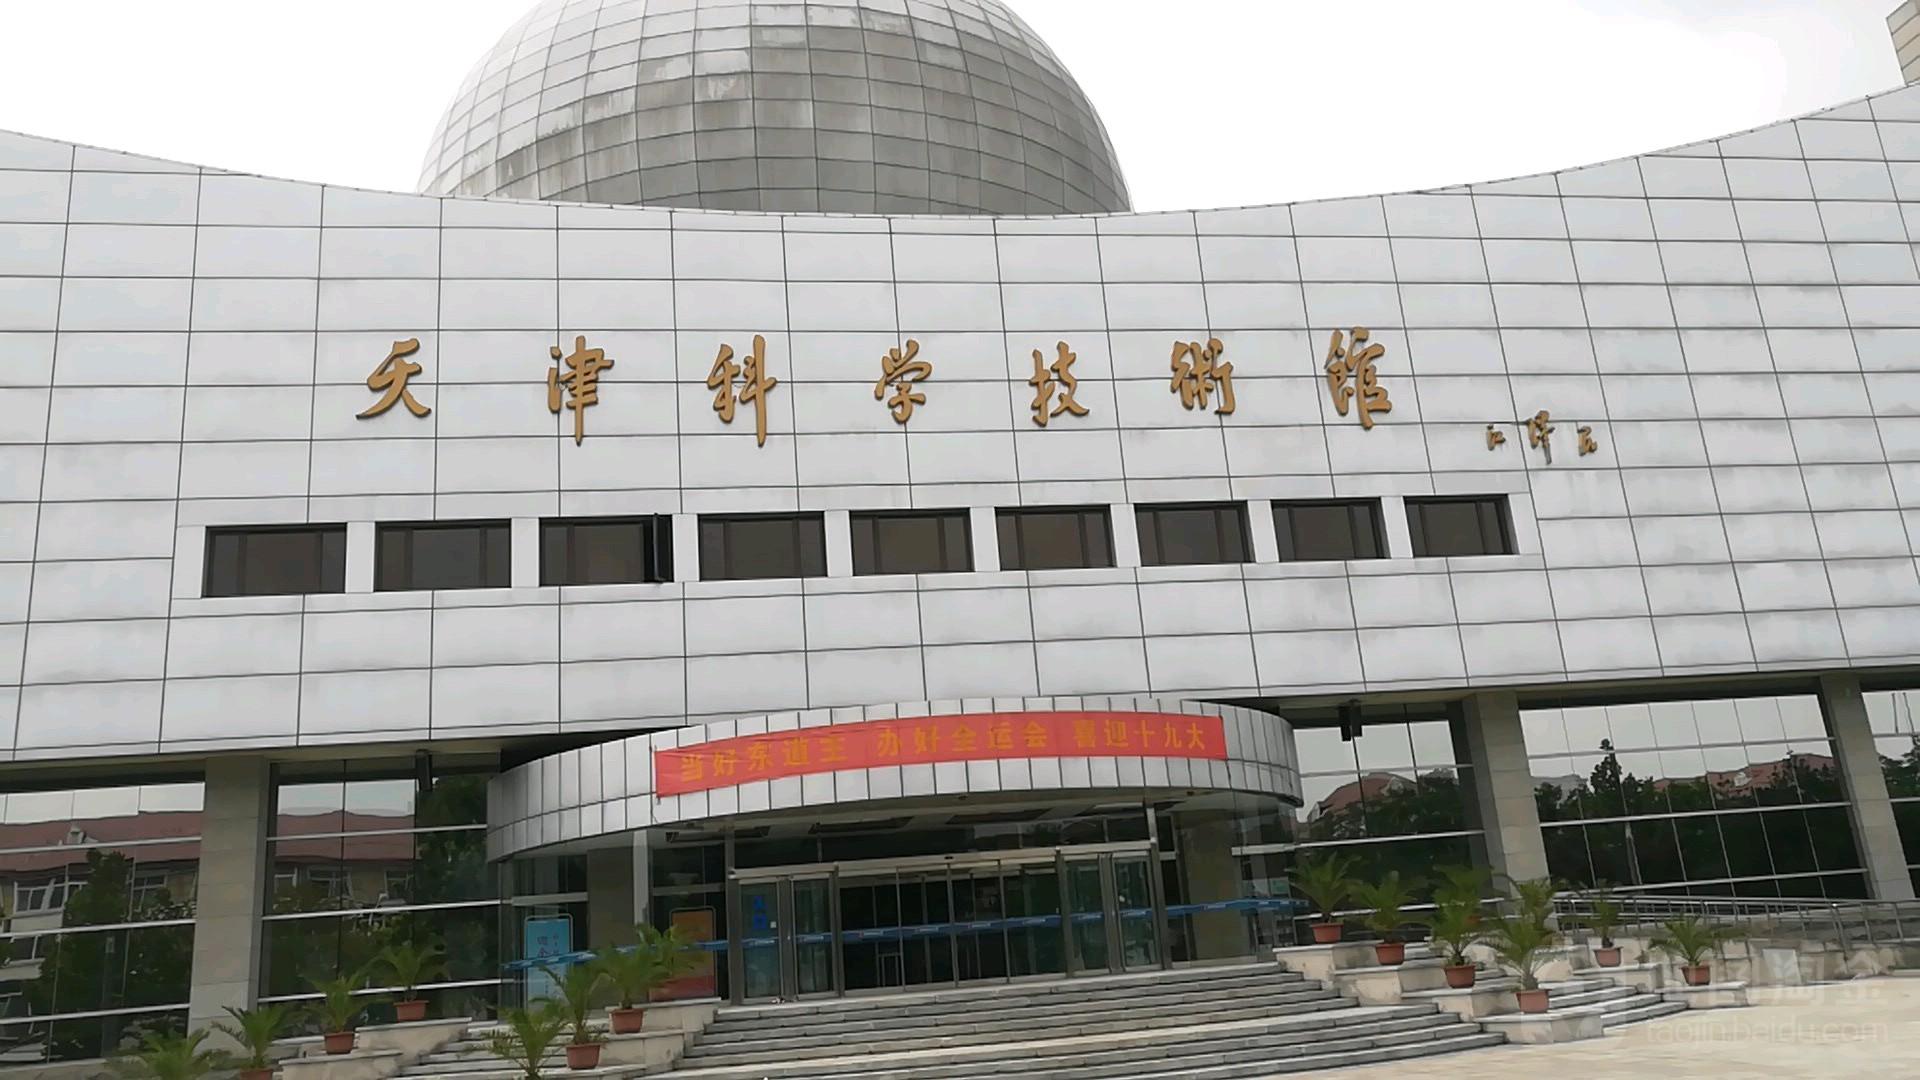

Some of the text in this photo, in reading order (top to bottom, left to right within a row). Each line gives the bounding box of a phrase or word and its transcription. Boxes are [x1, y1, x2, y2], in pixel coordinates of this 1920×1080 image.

[680, 718, 1206, 783] 当好东道主 办好全运会 喜迎十九大
